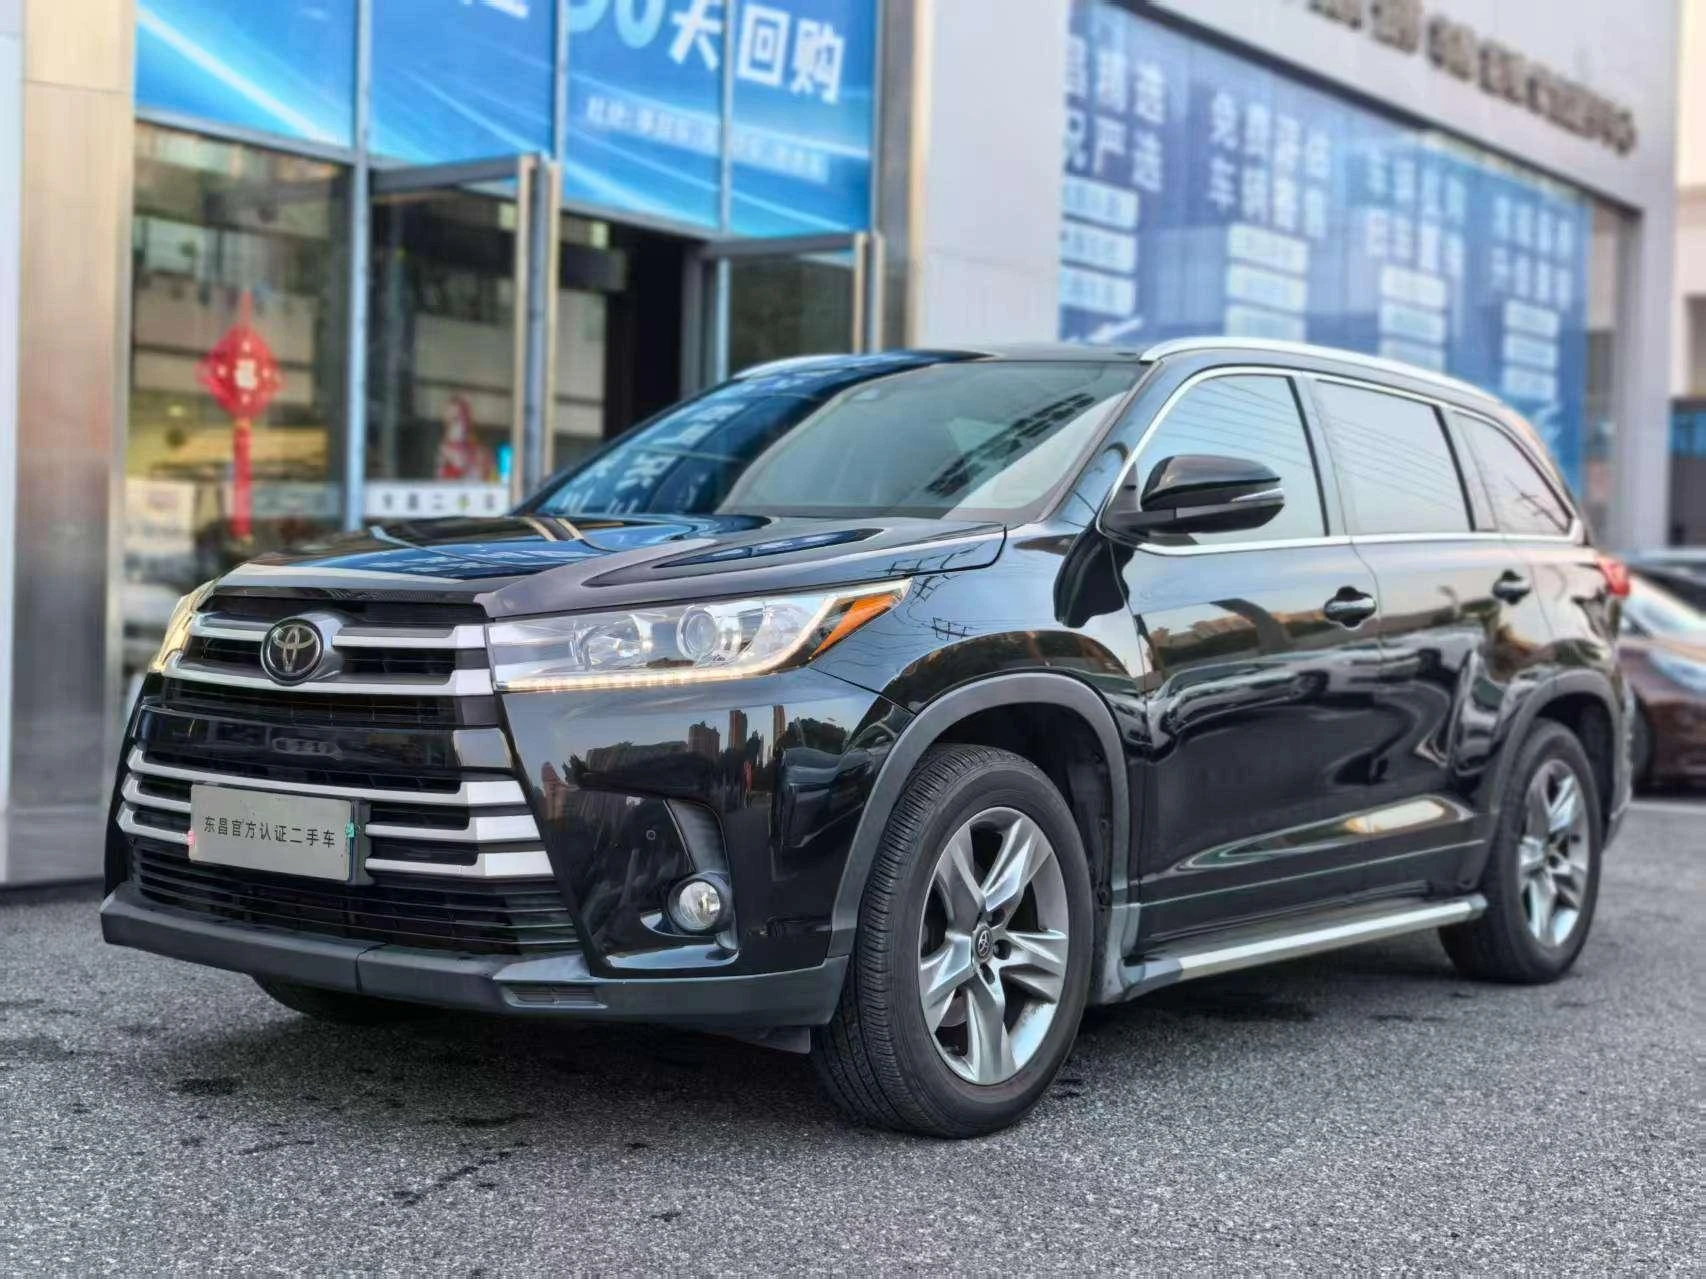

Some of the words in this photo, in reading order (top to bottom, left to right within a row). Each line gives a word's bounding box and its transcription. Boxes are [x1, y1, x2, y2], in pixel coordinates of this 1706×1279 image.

[203, 815, 336, 848] 东昌官方认证二手车
